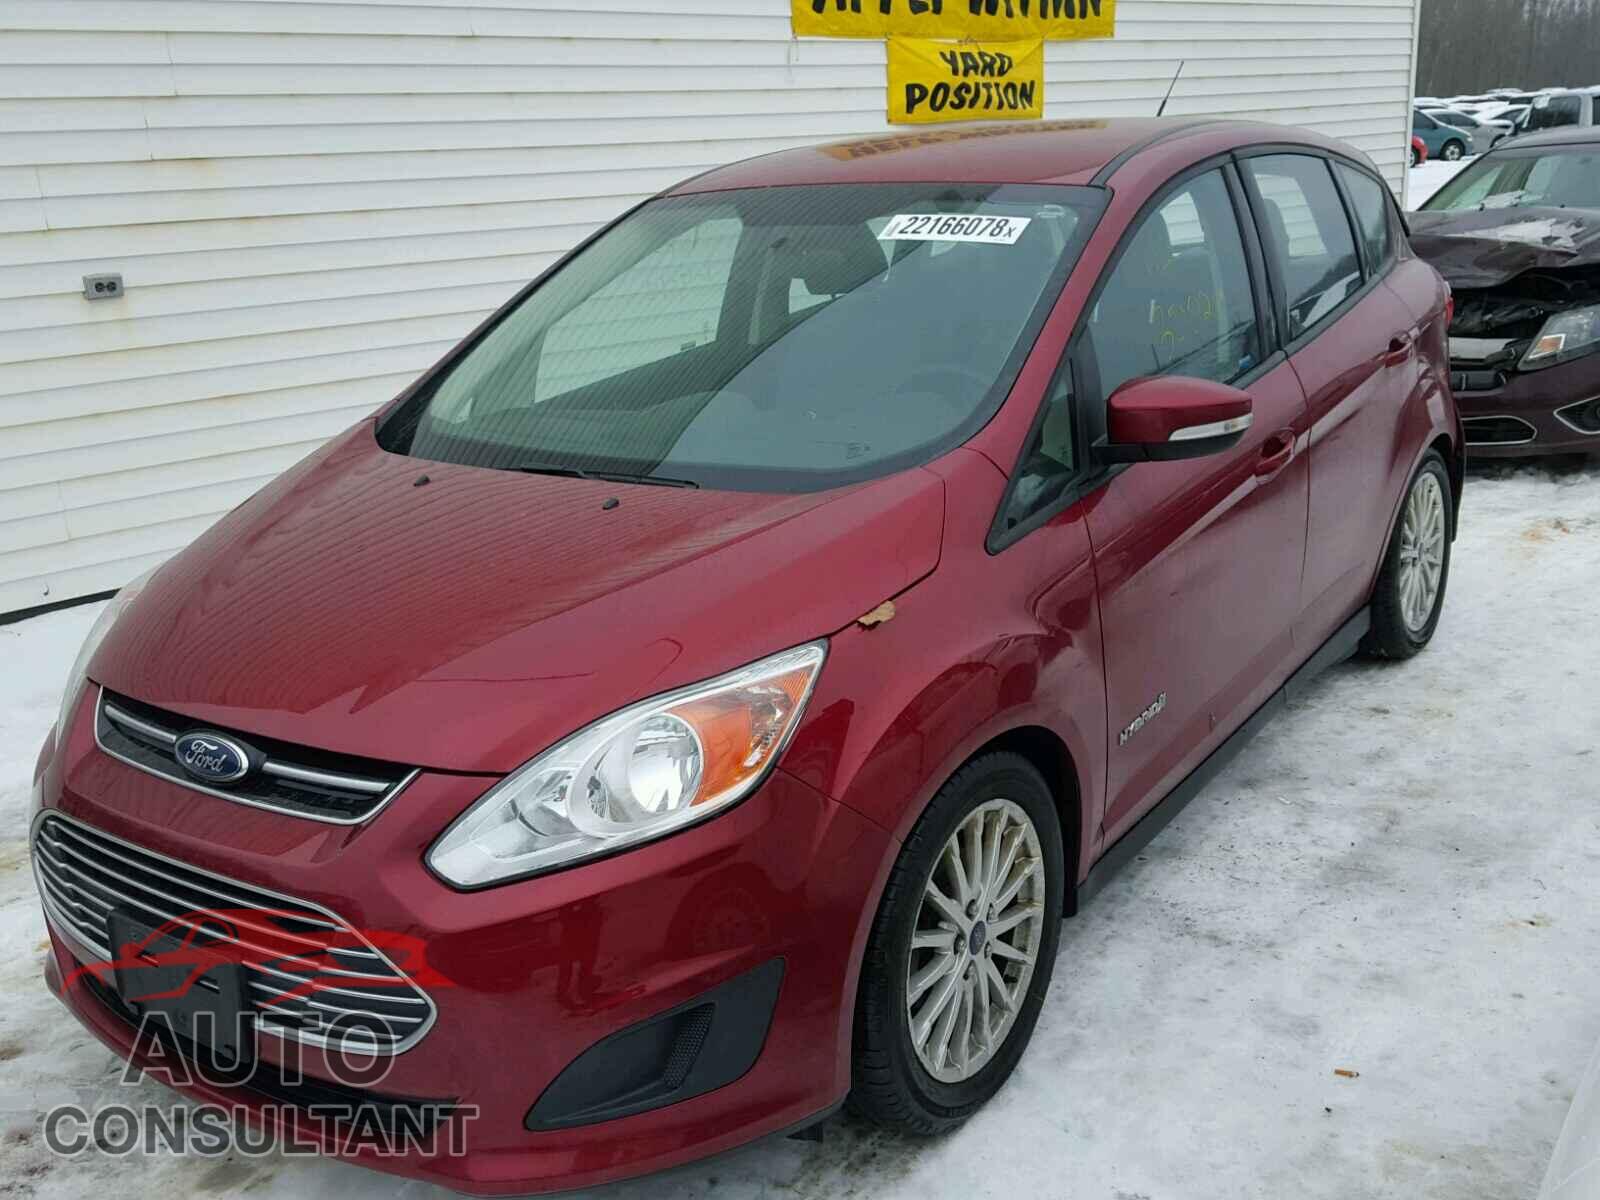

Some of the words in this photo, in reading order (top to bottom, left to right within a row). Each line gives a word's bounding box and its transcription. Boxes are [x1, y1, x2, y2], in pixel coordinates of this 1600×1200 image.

[939, 50, 1012, 77] YARD
[905, 80, 1035, 114] POSITION
[185, 740, 227, 772] Ford
